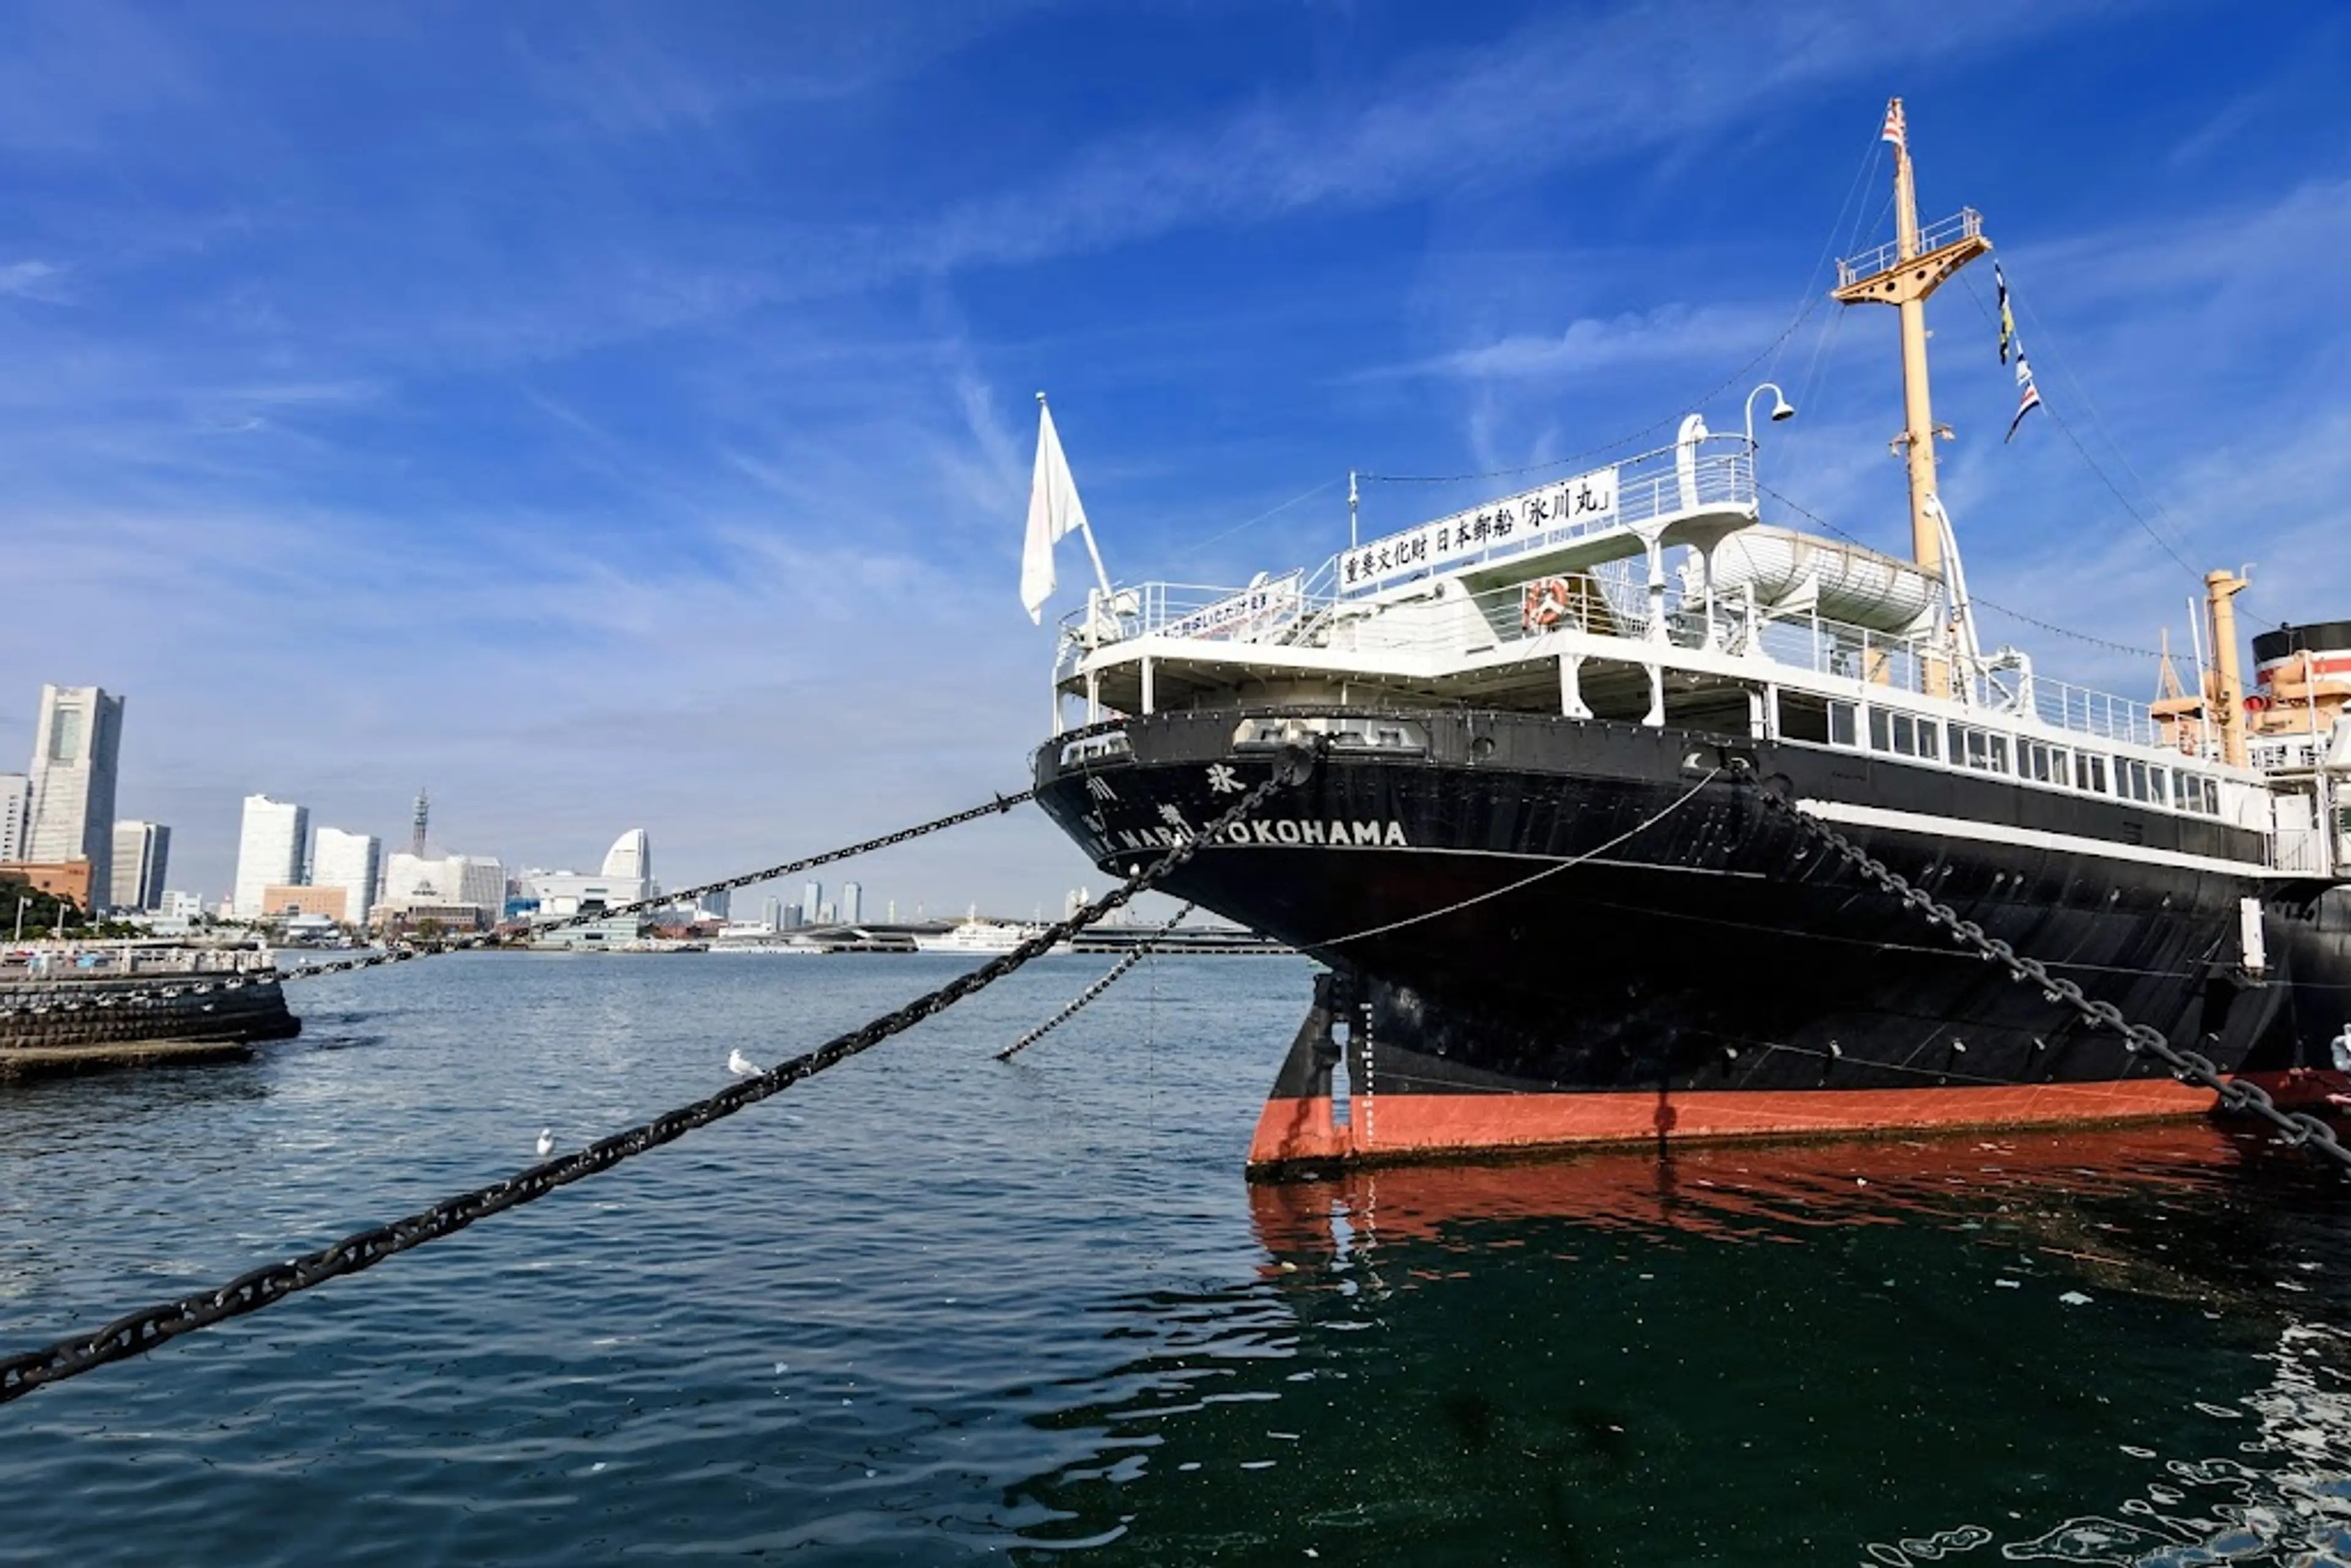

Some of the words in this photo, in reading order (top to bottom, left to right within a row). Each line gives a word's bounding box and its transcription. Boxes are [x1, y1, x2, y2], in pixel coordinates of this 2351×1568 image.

[1344, 534, 1428, 583] 重要文化財
[1437, 509, 1514, 552] 日本郵船
